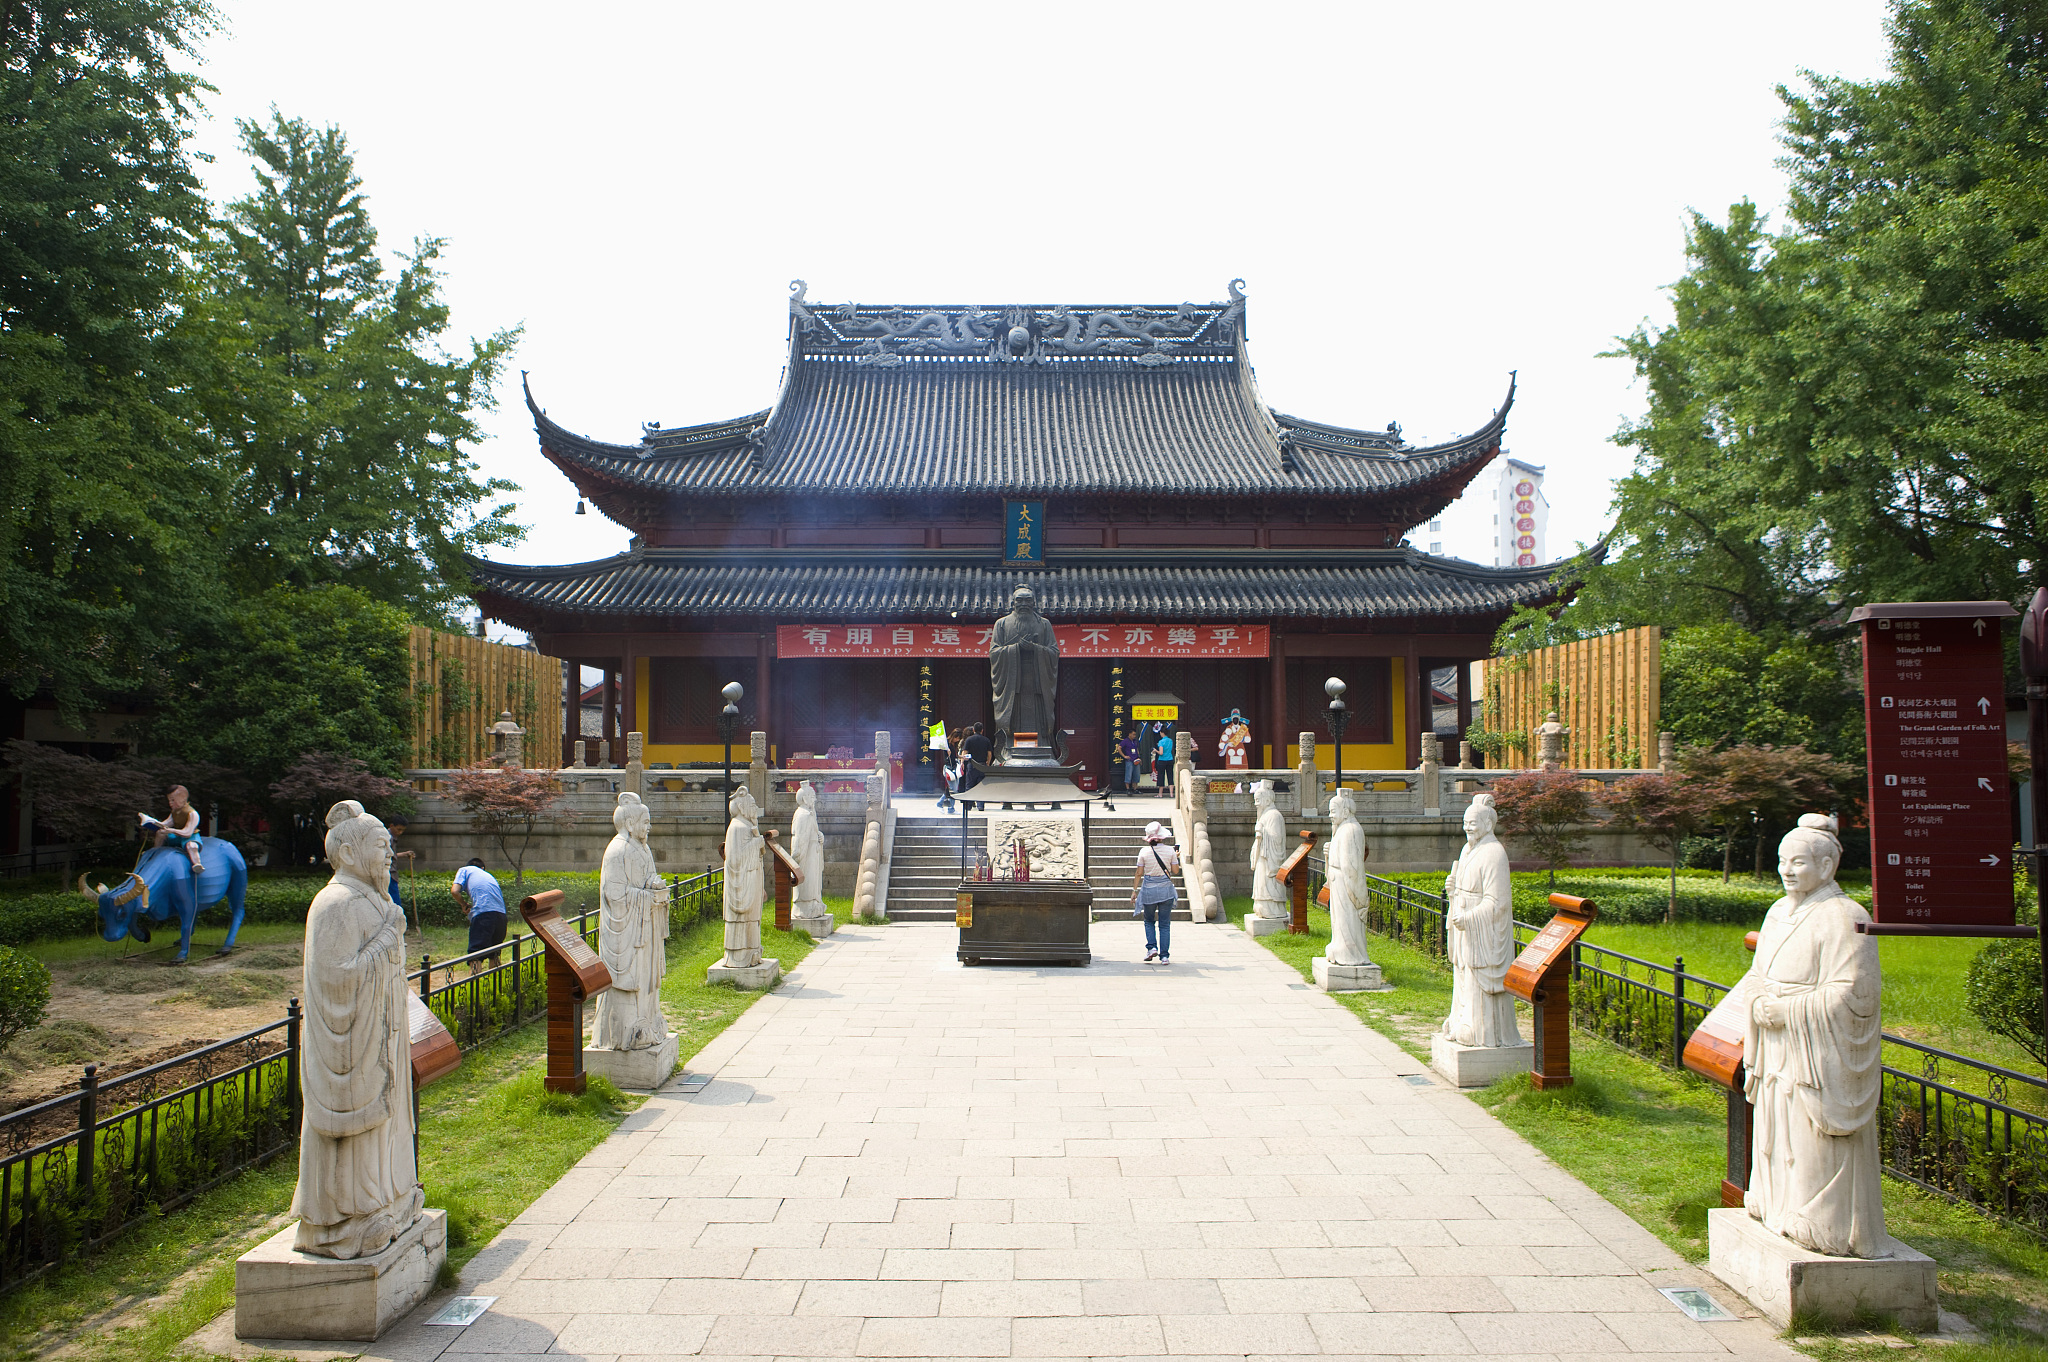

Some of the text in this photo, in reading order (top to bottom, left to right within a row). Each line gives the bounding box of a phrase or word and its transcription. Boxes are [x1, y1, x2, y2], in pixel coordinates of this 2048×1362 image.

[1013, 504, 1034, 559] 大成殿
[814, 646, 851, 654] How
[862, 646, 914, 655] happy
[955, 647, 989, 655] are,
[1078, 645, 1140, 654] friends
[1150, 645, 1190, 654] from
[1201, 646, 1241, 654] afar!
[1896, 646, 1925, 655] Mingde
[1915, 803, 1951, 811] Explaining
[1904, 856, 1930, 865] 洗手间
[1905, 895, 1927, 904] トイレ
[1906, 909, 1931, 917] 화장실
